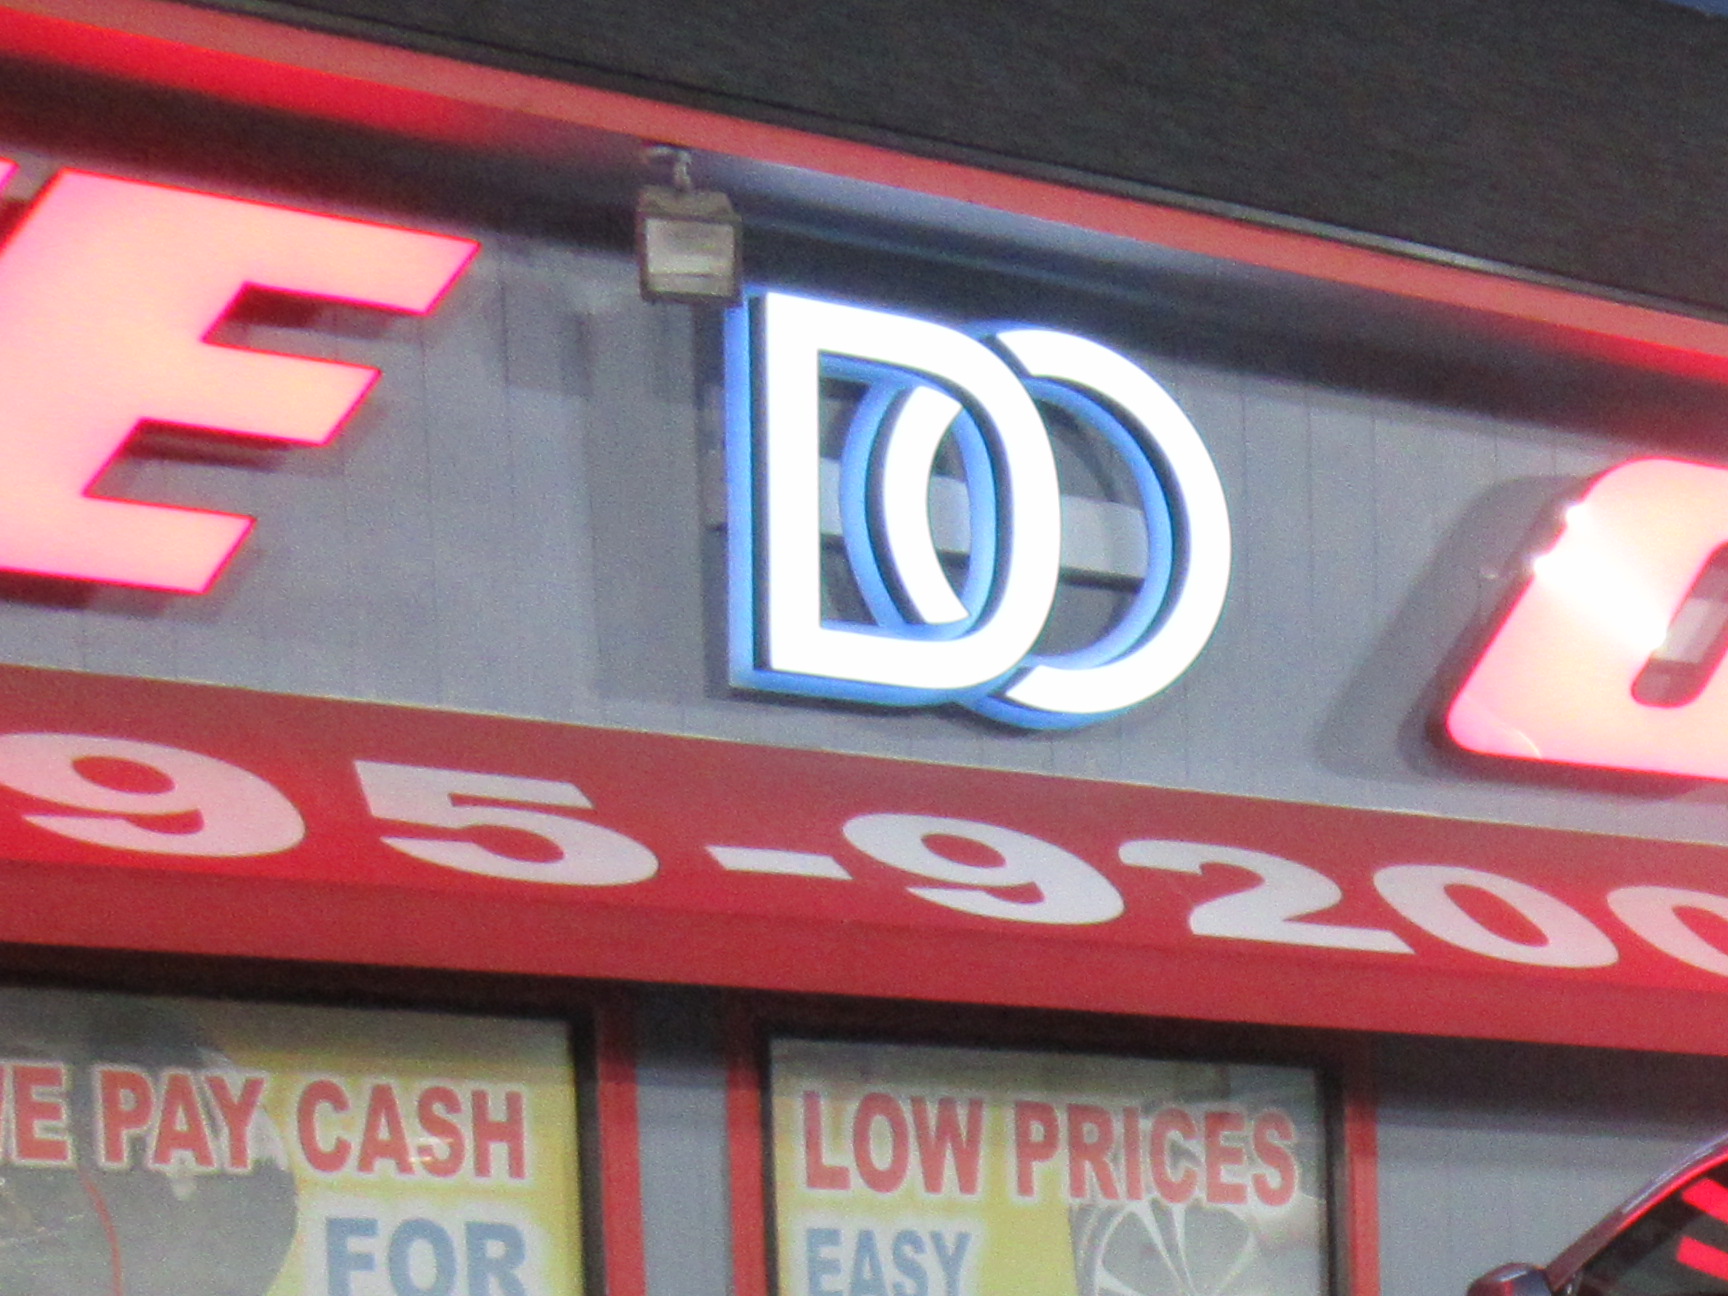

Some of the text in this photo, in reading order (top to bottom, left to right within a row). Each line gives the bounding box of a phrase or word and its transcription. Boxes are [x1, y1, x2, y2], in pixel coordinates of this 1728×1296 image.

[0, 158, 481, 596] E
[0, 1062, 527, 1180] E PAY CASH
[803, 1088, 1297, 1207] LOW PRICES
